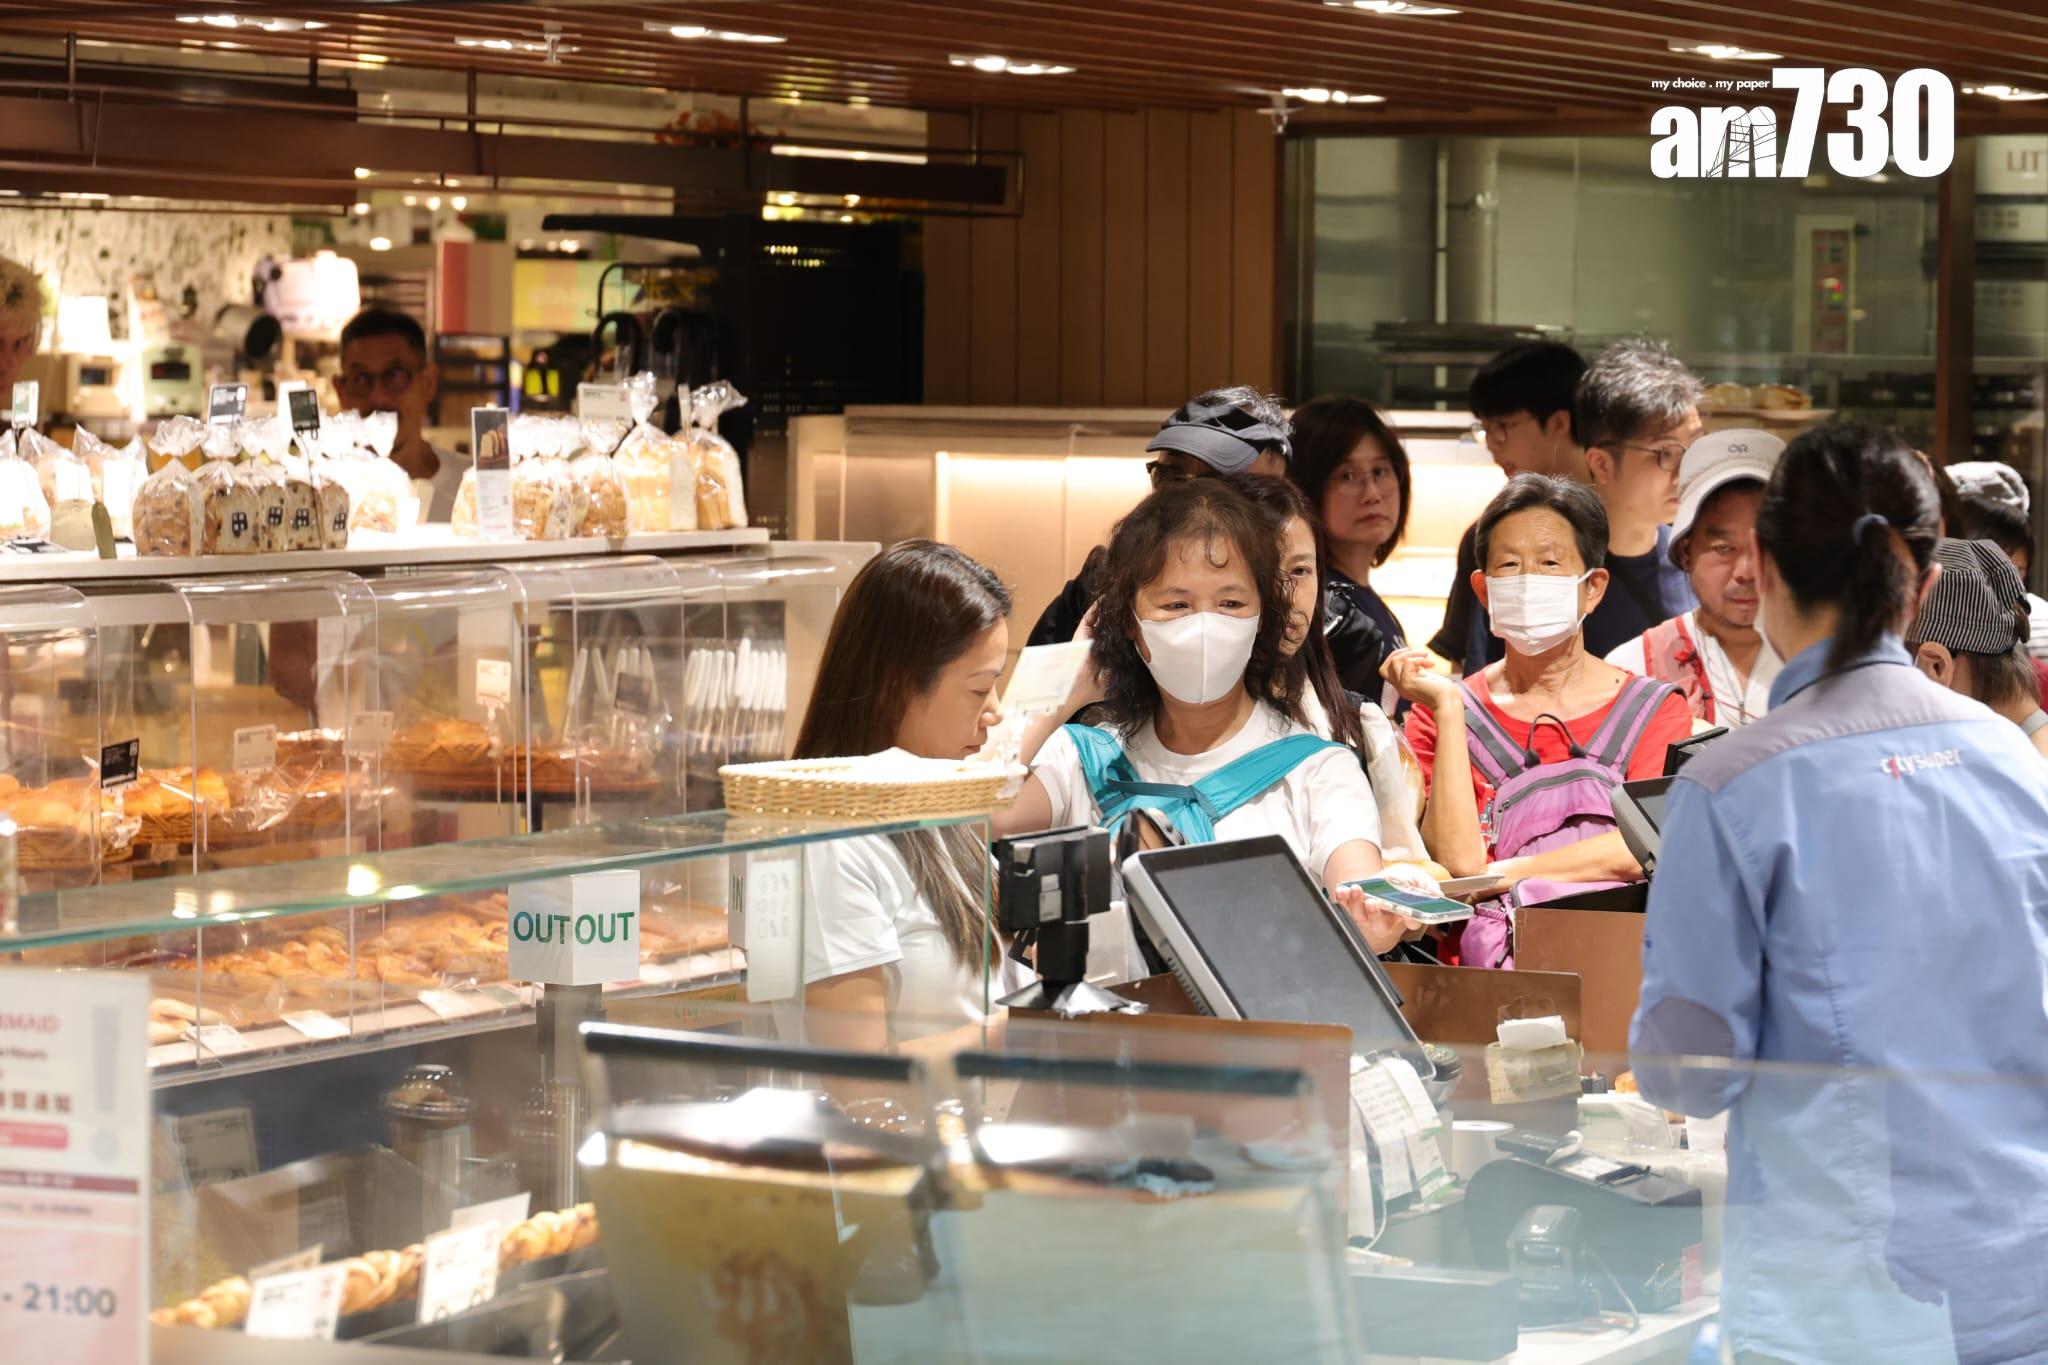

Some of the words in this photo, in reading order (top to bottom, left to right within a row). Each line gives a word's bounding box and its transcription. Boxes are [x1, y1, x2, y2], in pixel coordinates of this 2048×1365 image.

[1727, 443, 1748, 454] OR
[732, 873, 744, 913] IN
[513, 911, 571, 945] OUT
[575, 911, 635, 945] OUT
[22, 1281, 118, 1319] 21:00
